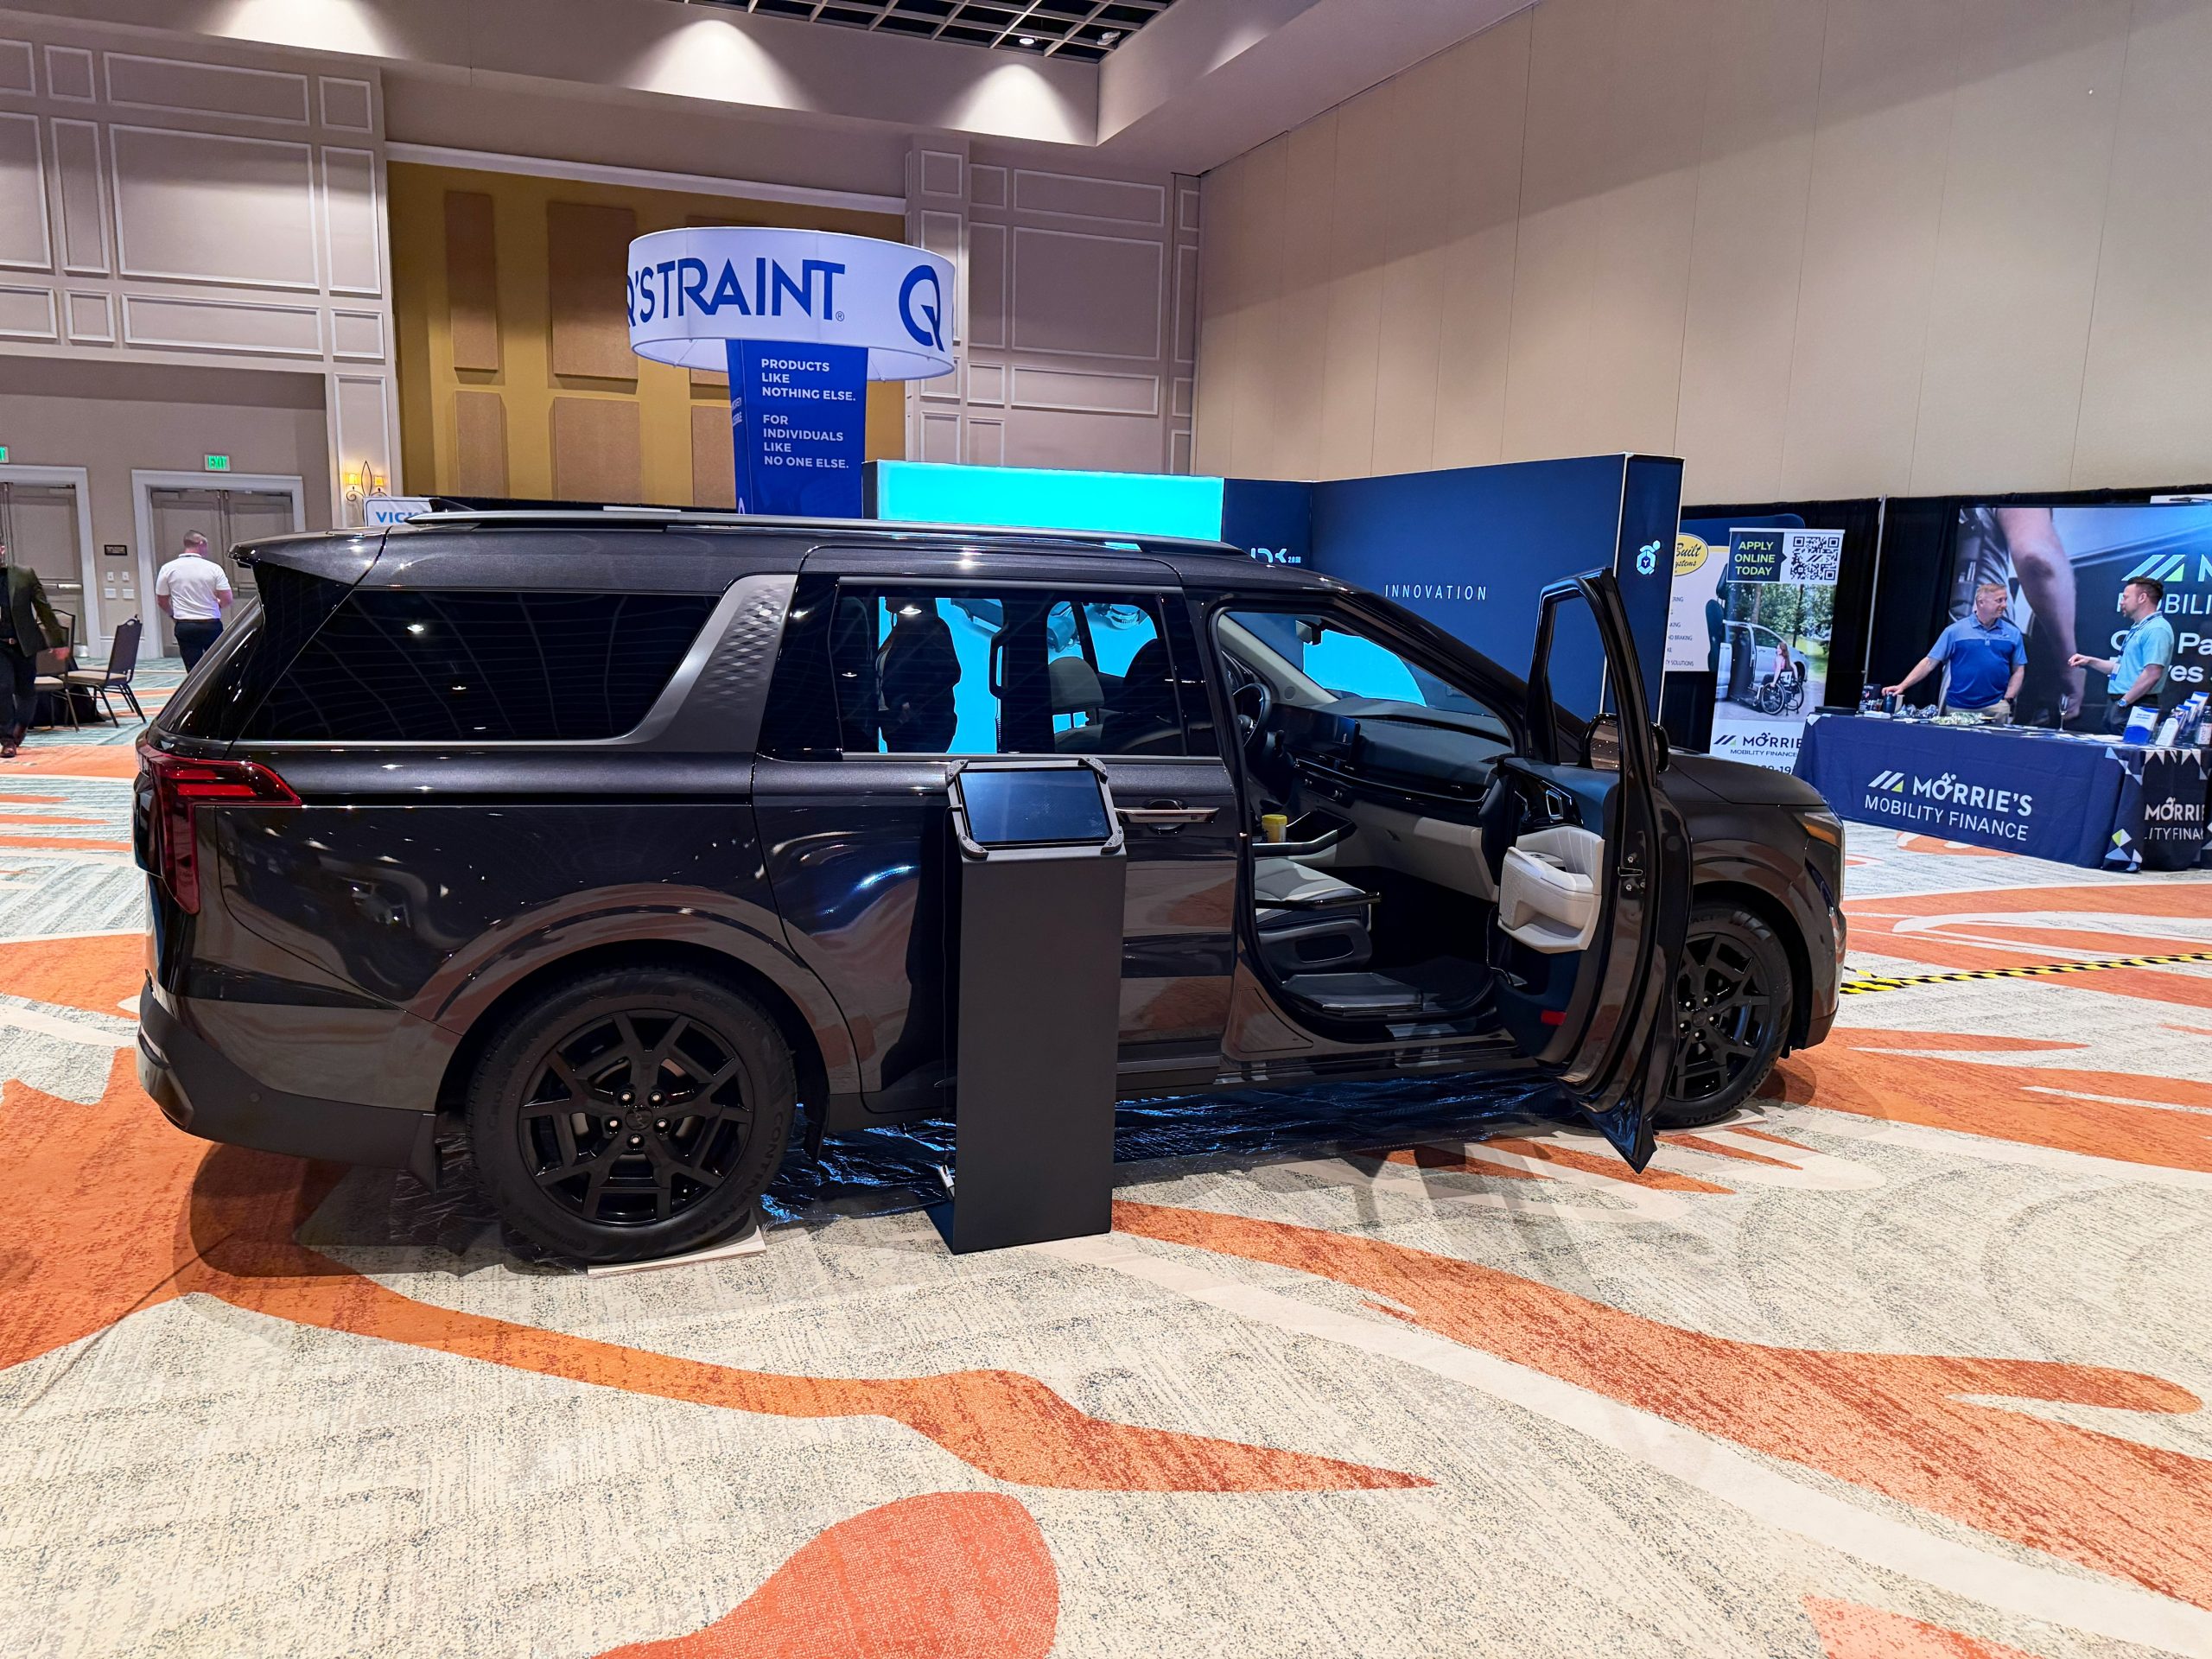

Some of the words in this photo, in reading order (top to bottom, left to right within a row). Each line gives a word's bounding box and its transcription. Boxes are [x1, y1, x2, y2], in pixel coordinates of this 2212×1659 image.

[899, 264, 945, 353] Q
[761, 359, 830, 372] PRODUCTS
[761, 372, 790, 383] LIKE
[762, 386, 820, 399] NOTHING
[823, 390, 856, 401] ELSE.
[763, 414, 788, 424] FOR
[763, 429, 843, 442] INDIVIDUALS
[764, 442, 791, 452] LIKE
[765, 455, 783, 466] NO
[785, 457, 813, 467] ONE
[816, 458, 849, 468] ELSE.
[376, 512, 422, 524] VIC
[1738, 541, 1774, 550] APPLY
[1675, 560, 1697, 569] ystems
[1734, 553, 1776, 563] ONLINE
[1735, 566, 1772, 576] TODAY
[1384, 584, 1486, 601] INNOVATION
[1743, 732, 1802, 749] MORRIE
[1912, 772, 2032, 817] MORRIE'S
[2144, 797, 2205, 821] MORRI
[1865, 794, 1944, 823] MOBILITY
[1948, 810, 2029, 842] FINANCE
